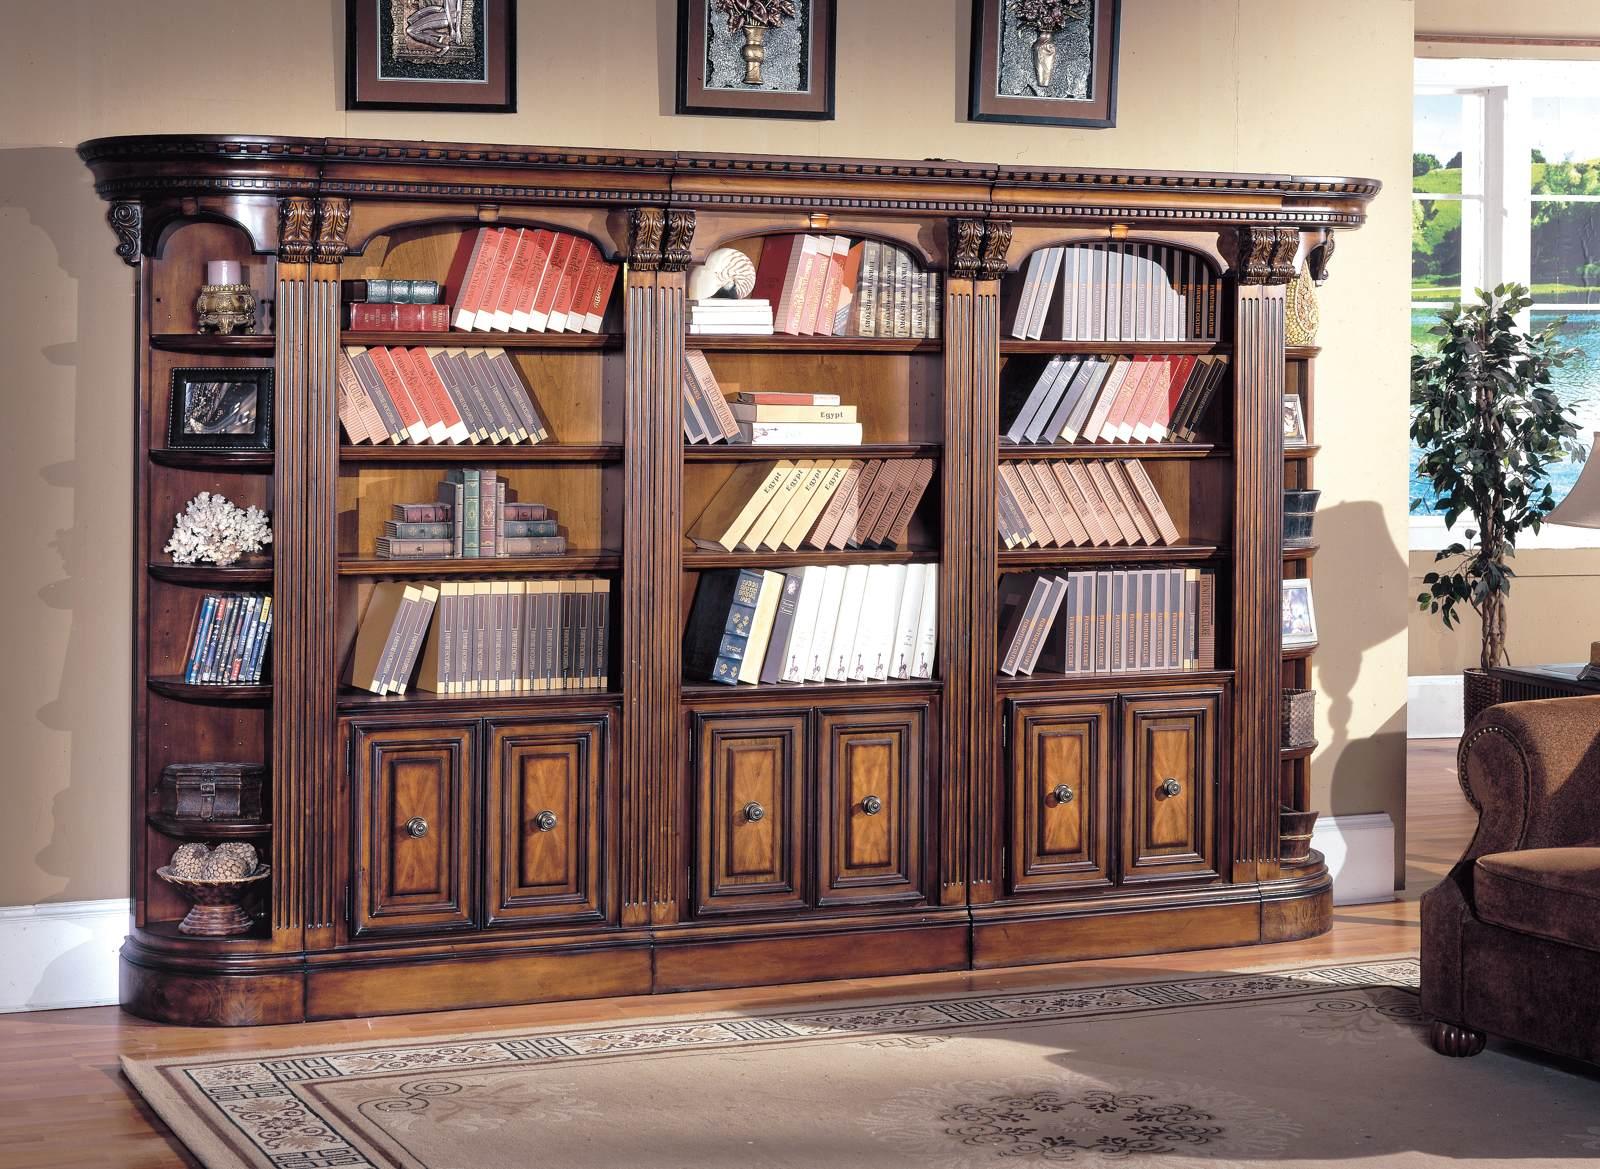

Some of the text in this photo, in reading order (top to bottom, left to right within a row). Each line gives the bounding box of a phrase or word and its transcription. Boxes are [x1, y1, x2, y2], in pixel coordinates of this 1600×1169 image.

[820, 411, 844, 419] Egypt
[763, 472, 782, 493] Egypt
[785, 469, 803, 491] Egypt
[804, 469, 822, 491] Egypt
[824, 468, 841, 490] Egypt
